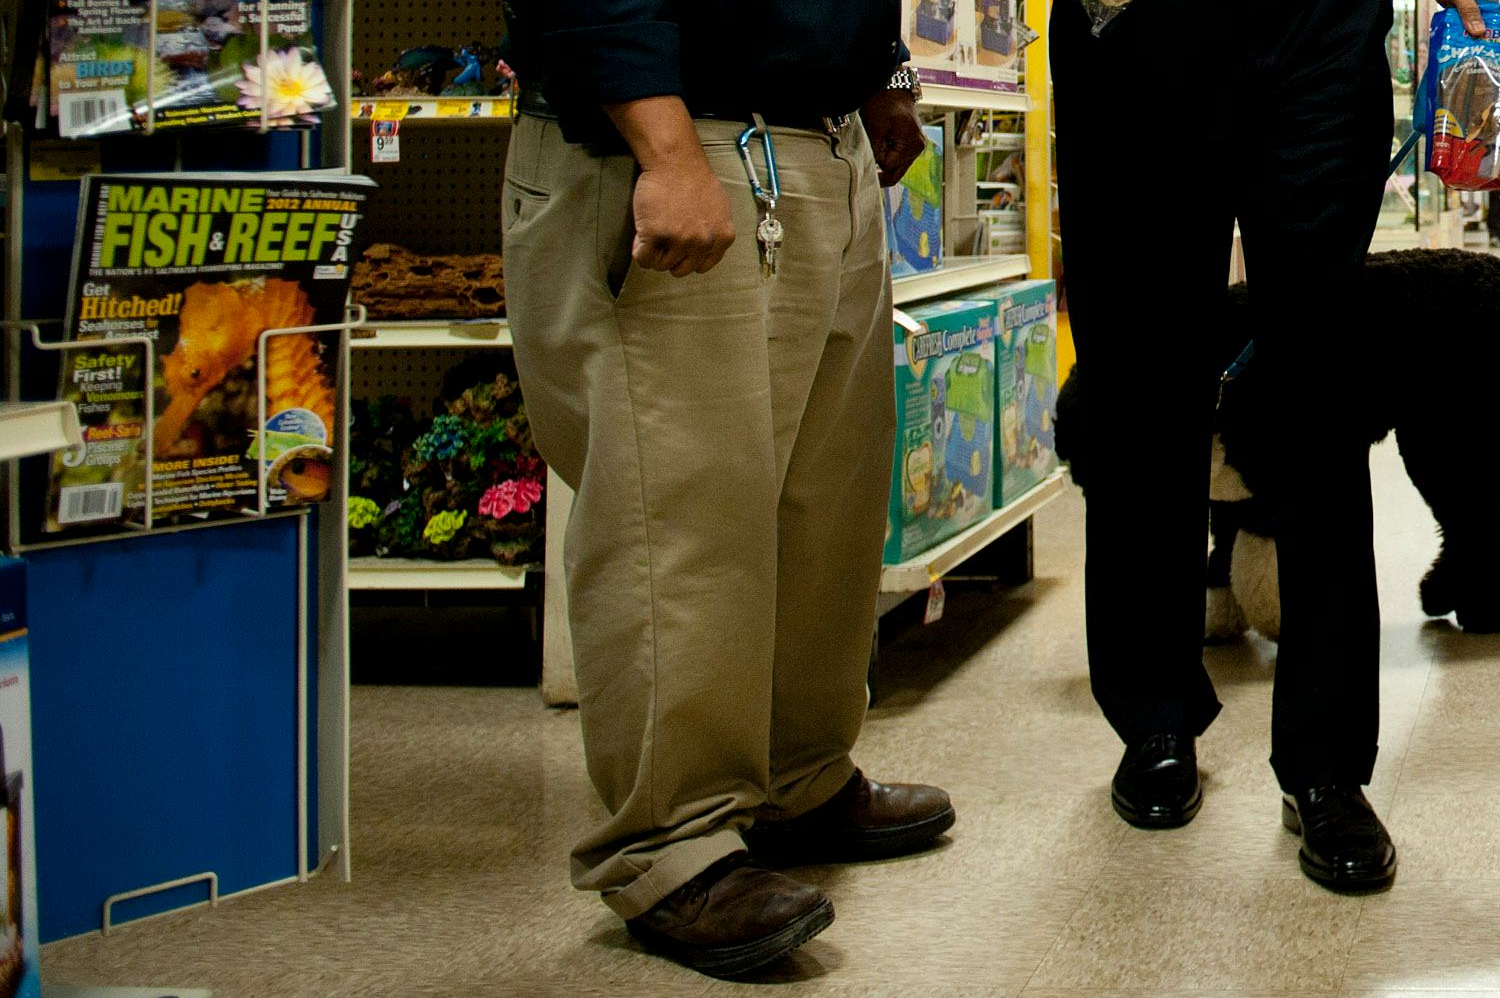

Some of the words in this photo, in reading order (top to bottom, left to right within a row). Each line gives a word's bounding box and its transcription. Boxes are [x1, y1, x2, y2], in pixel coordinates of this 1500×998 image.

[75, 59, 136, 80] BIRDS
[107, 185, 267, 213] MARINE
[266, 198, 300, 209] 2012
[302, 199, 358, 212] ANNUAL
[99, 212, 215, 269] FISH
[208, 231, 225, 253] &
[223, 212, 343, 264] REEF
[82, 282, 111, 297] Get
[79, 292, 183, 320] Hitched!
[78, 319, 145, 333] Seahorses
[943, 324, 977, 352] Complete
[74, 353, 137, 370] Safety
[73, 366, 122, 384] First!
[77, 402, 112, 414] Fishes
[192, 454, 240, 469] INSIDE!
